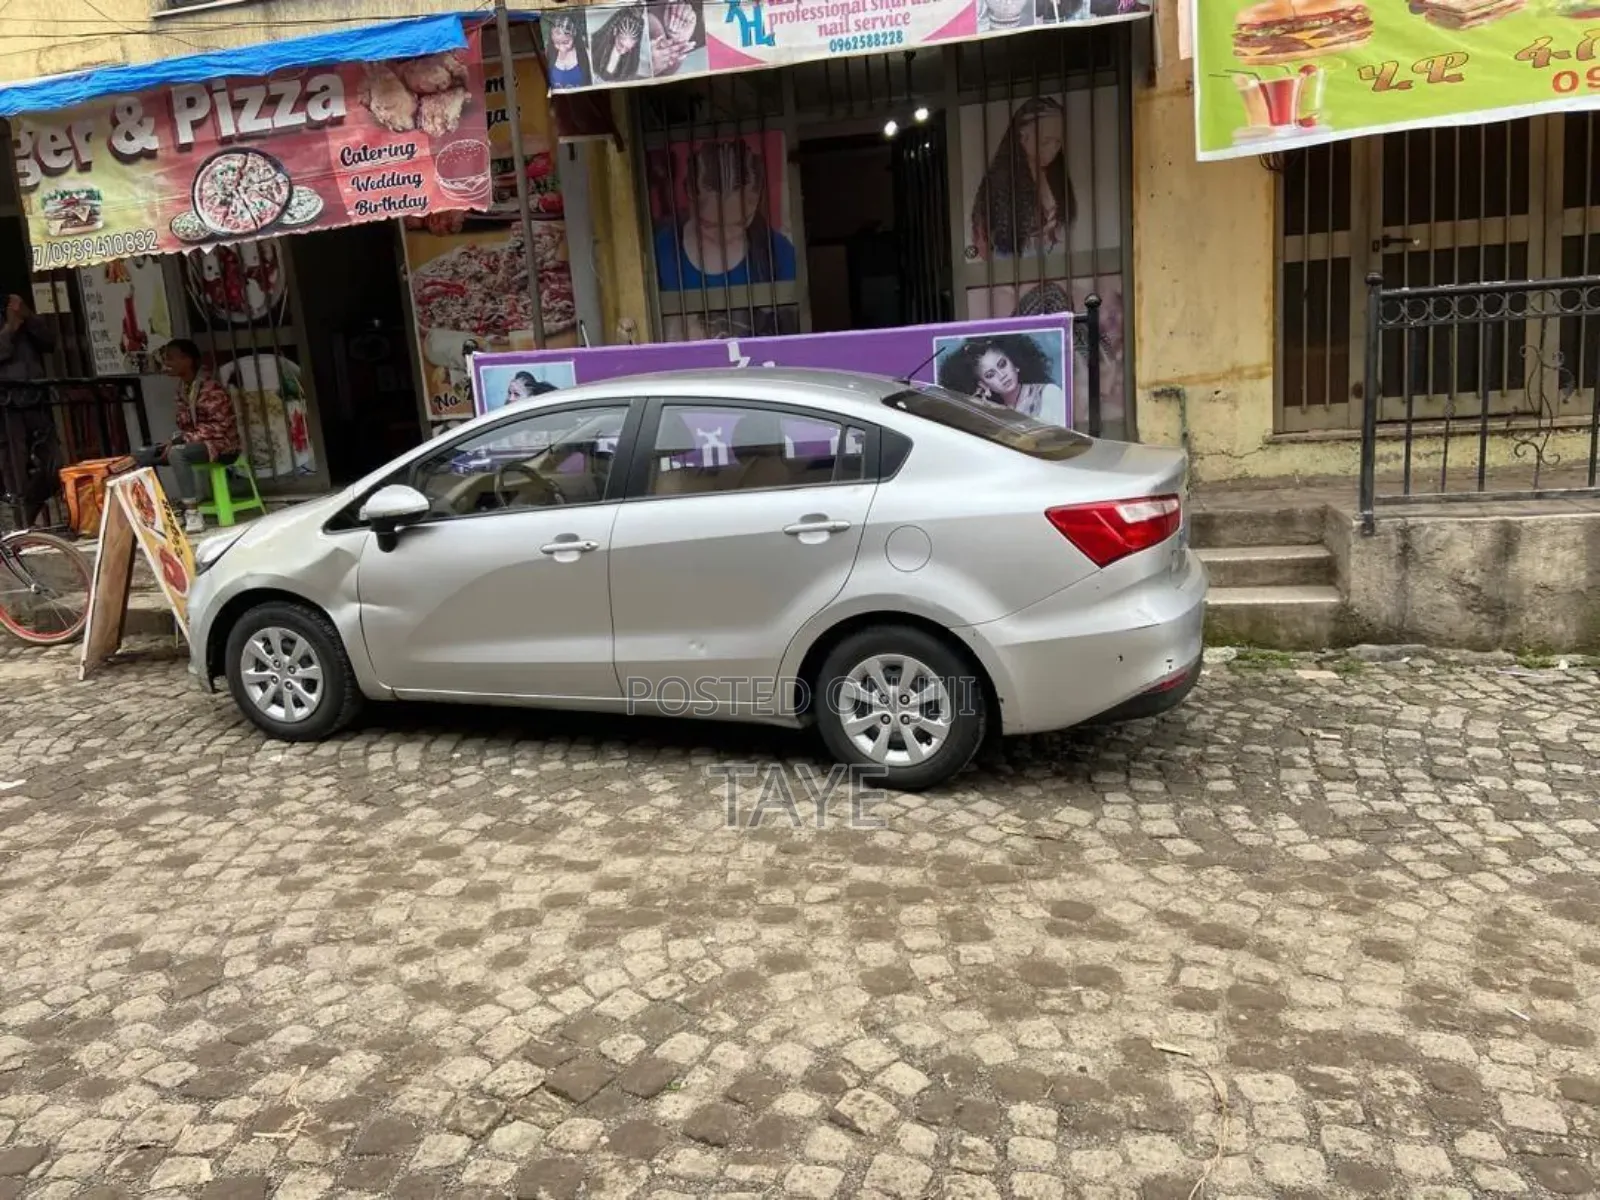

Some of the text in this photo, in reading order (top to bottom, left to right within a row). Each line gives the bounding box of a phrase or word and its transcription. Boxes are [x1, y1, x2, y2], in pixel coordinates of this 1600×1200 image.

[767, 0, 866, 32] professional
[818, 9, 911, 37] nail service
[829, 30, 903, 53] 0962588228
[109, 96, 160, 158] &
[171, 73, 347, 145] Pizza
[340, 143, 417, 167] Catering
[351, 171, 424, 192] Wedding
[355, 193, 428, 216] Birthday
